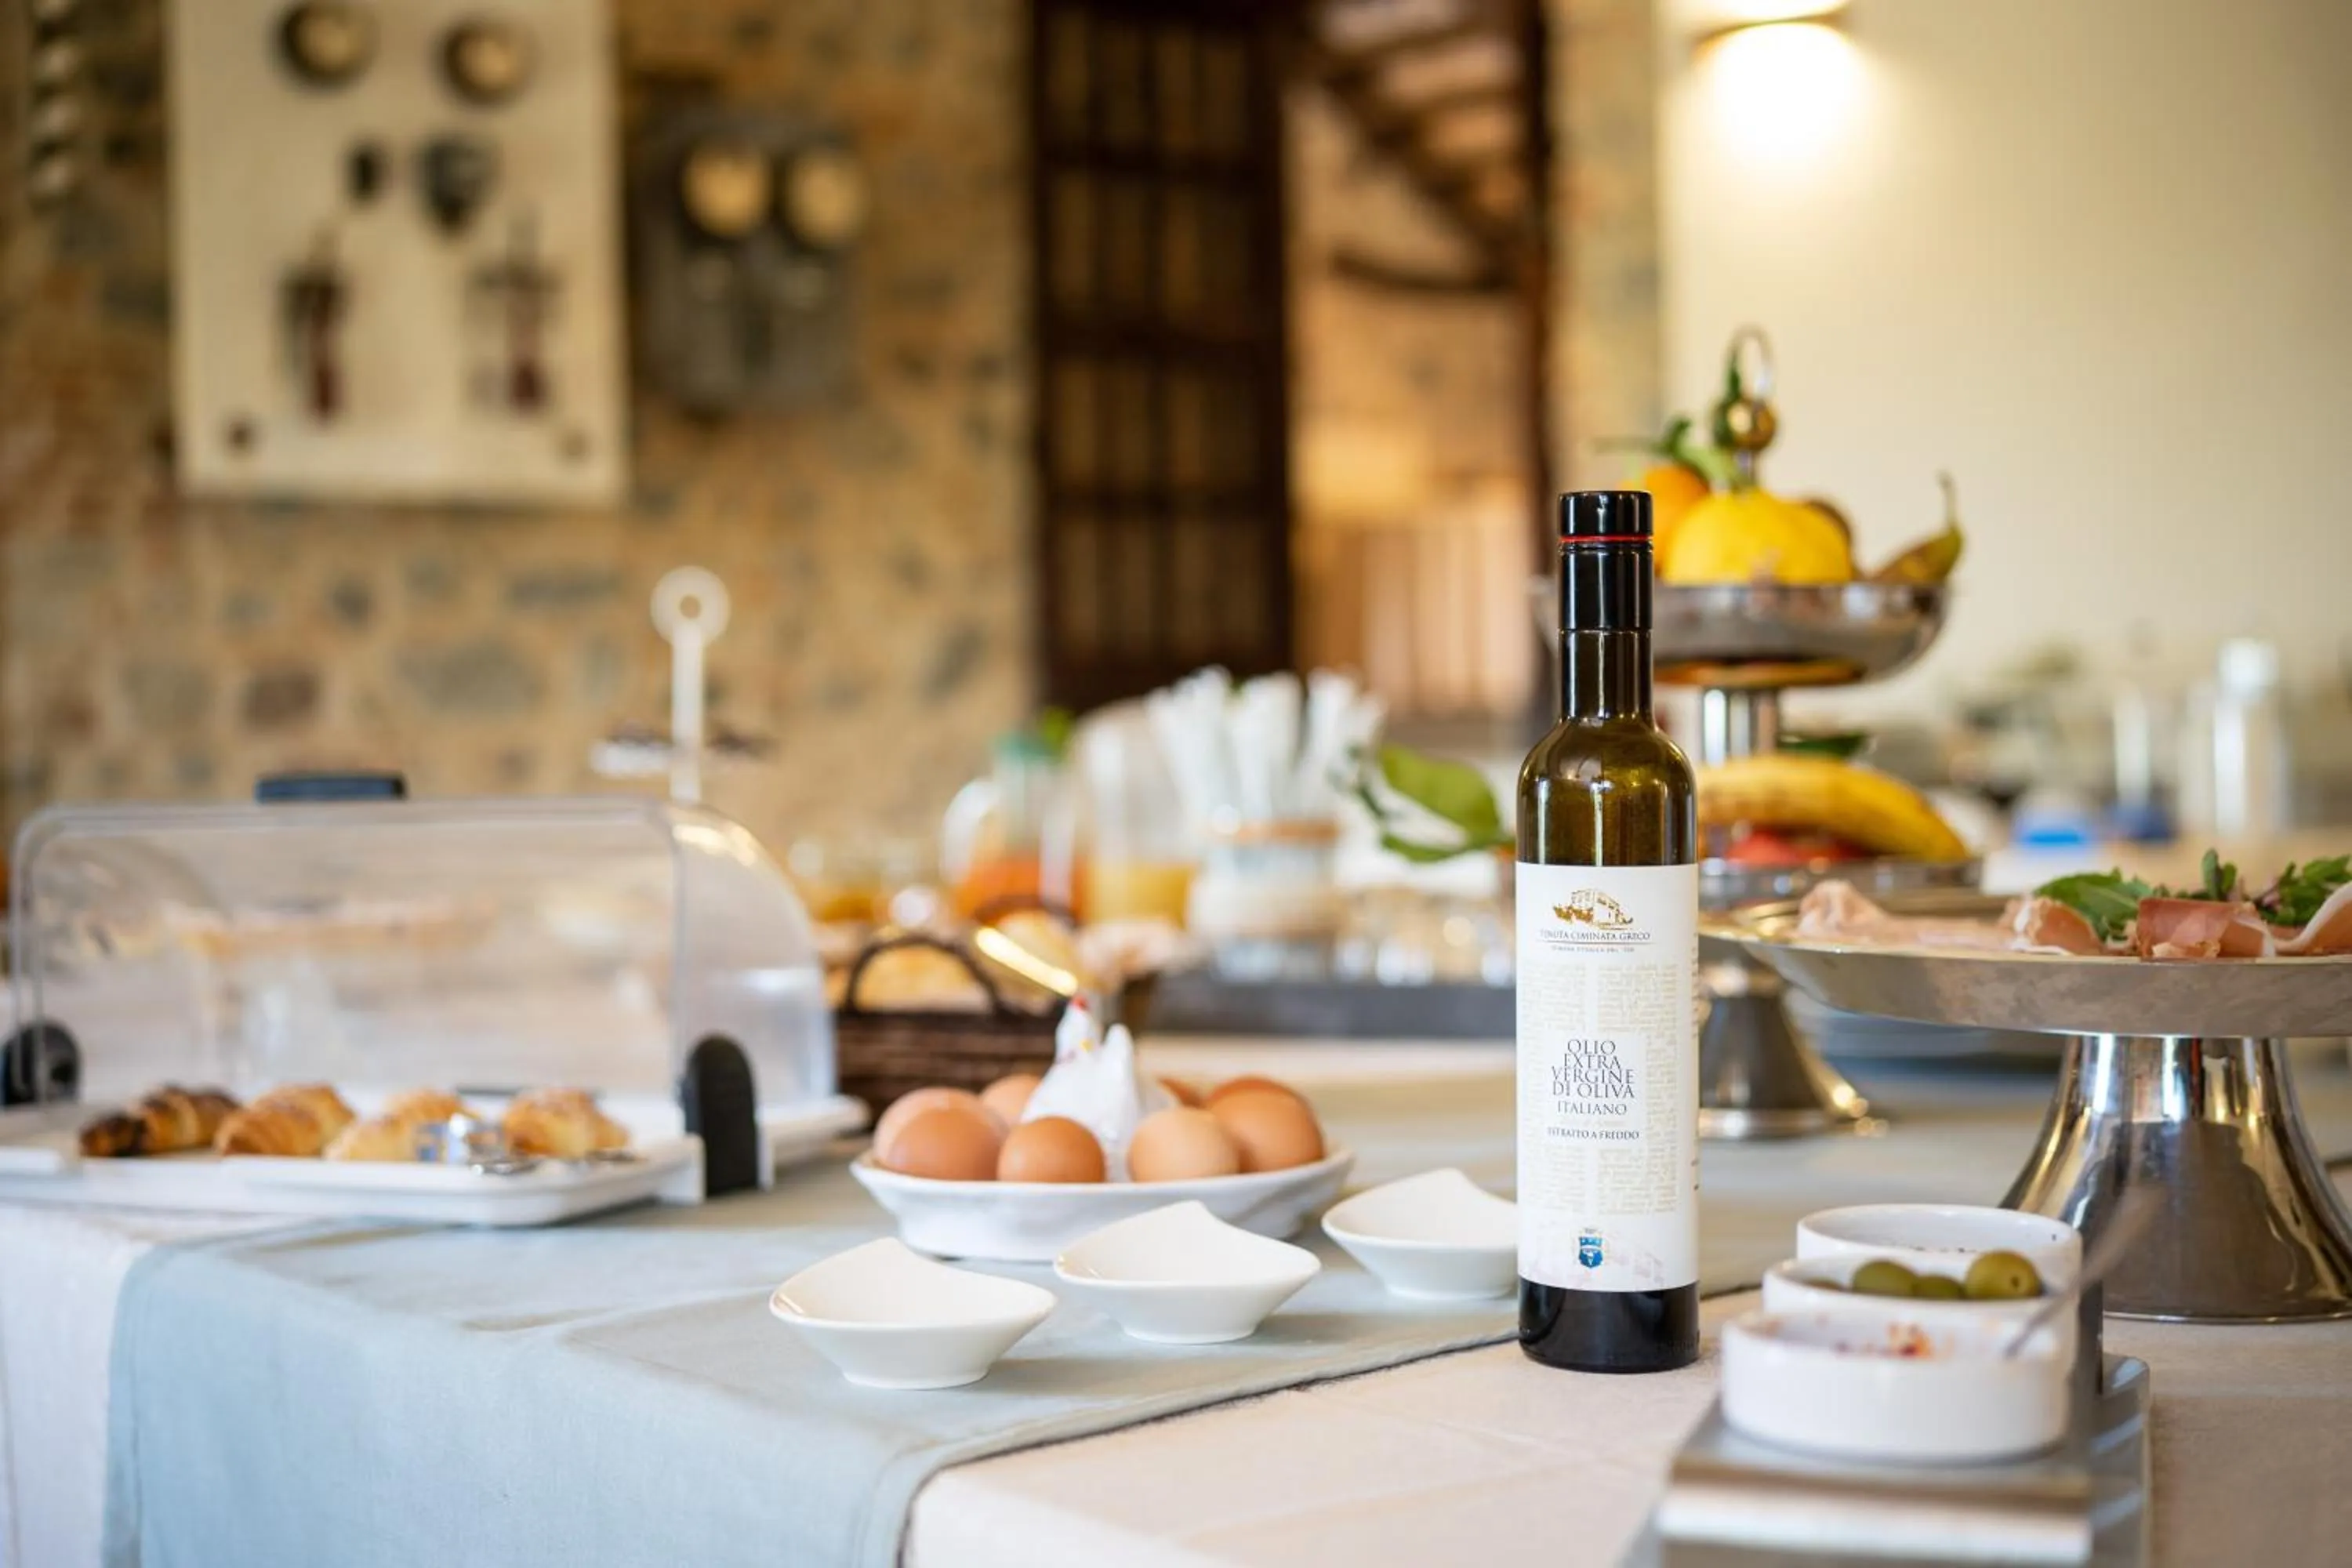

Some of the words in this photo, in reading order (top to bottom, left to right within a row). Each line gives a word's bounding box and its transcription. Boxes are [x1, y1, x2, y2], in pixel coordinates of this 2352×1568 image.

[1567, 1039, 1616, 1054] OLIO
[1564, 1053, 1621, 1069] EXTRA
[1552, 1065, 1635, 1083] VERGINE
[1552, 1081, 1570, 1096] DI
[1577, 1083, 1635, 1098] OLIVA
[1557, 1100, 1627, 1115] ITALIANO
[1592, 1131, 1598, 1139] A
